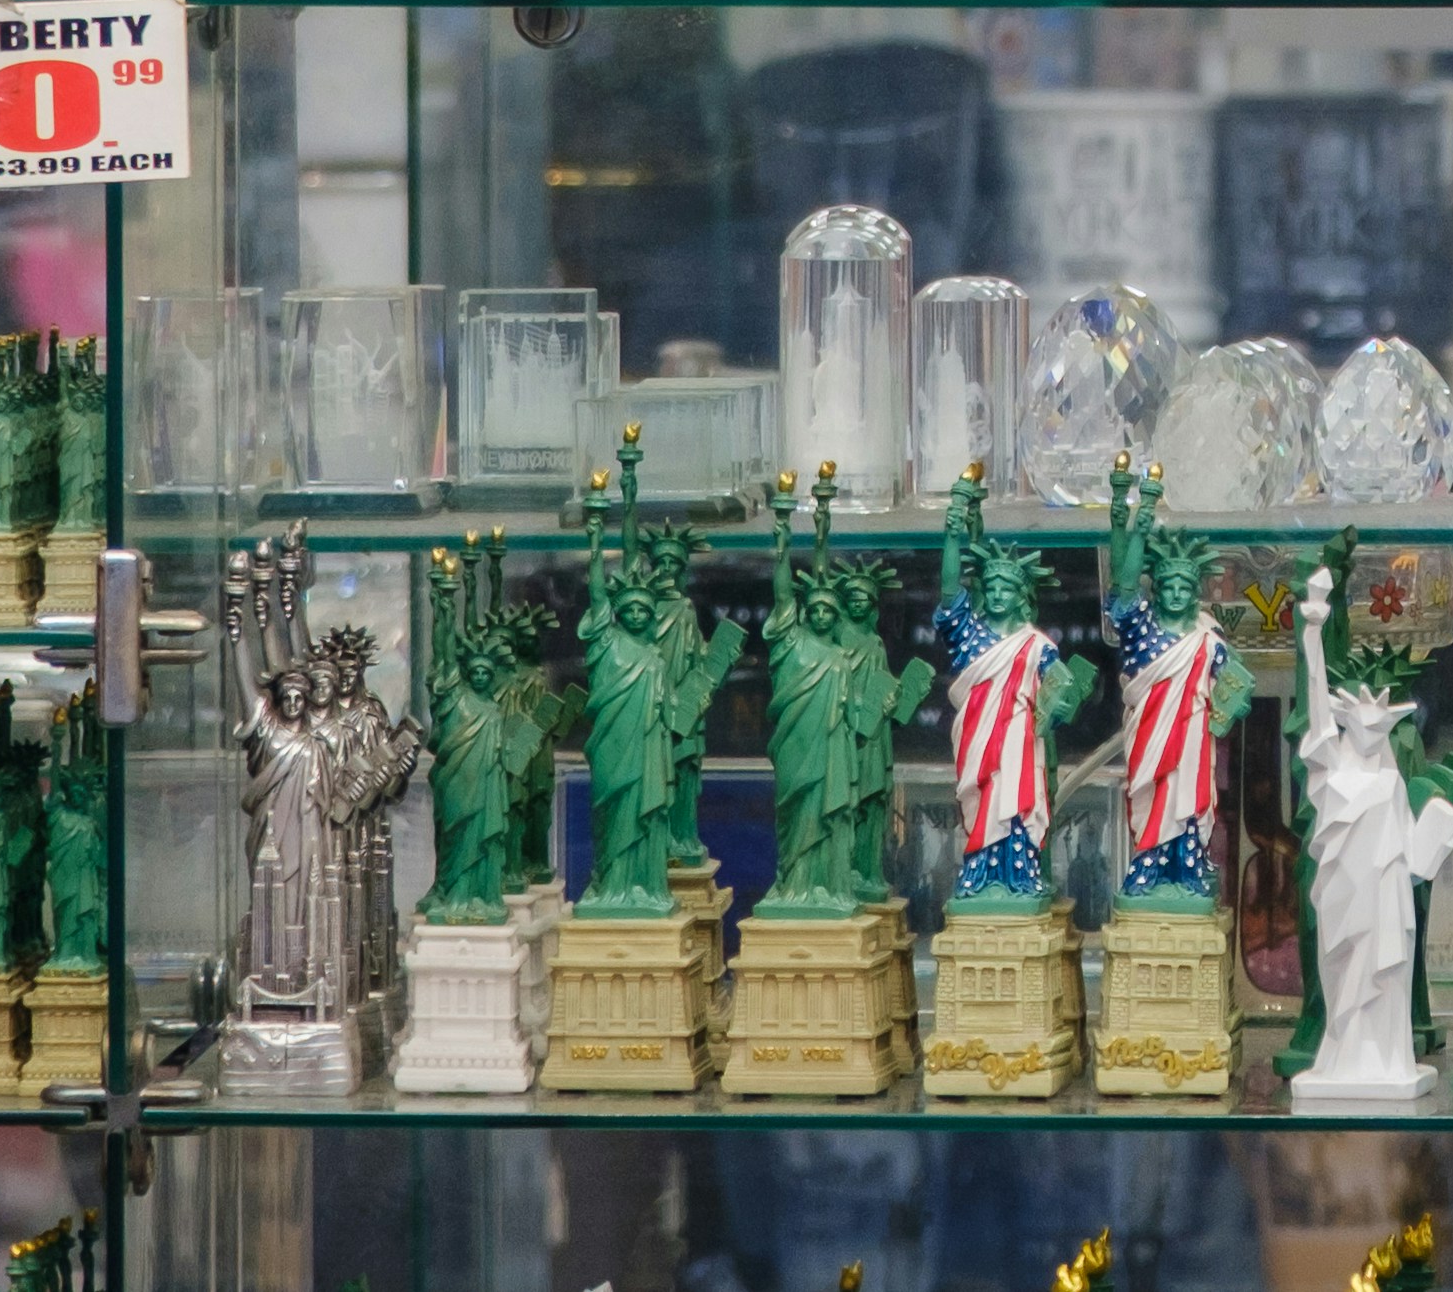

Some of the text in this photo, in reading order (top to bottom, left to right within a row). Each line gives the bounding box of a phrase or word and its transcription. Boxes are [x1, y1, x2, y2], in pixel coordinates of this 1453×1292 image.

[90, 151, 174, 174] EACH
[572, 1045, 664, 1061] NEW YORK
[753, 1045, 845, 1062] NEW YORK
